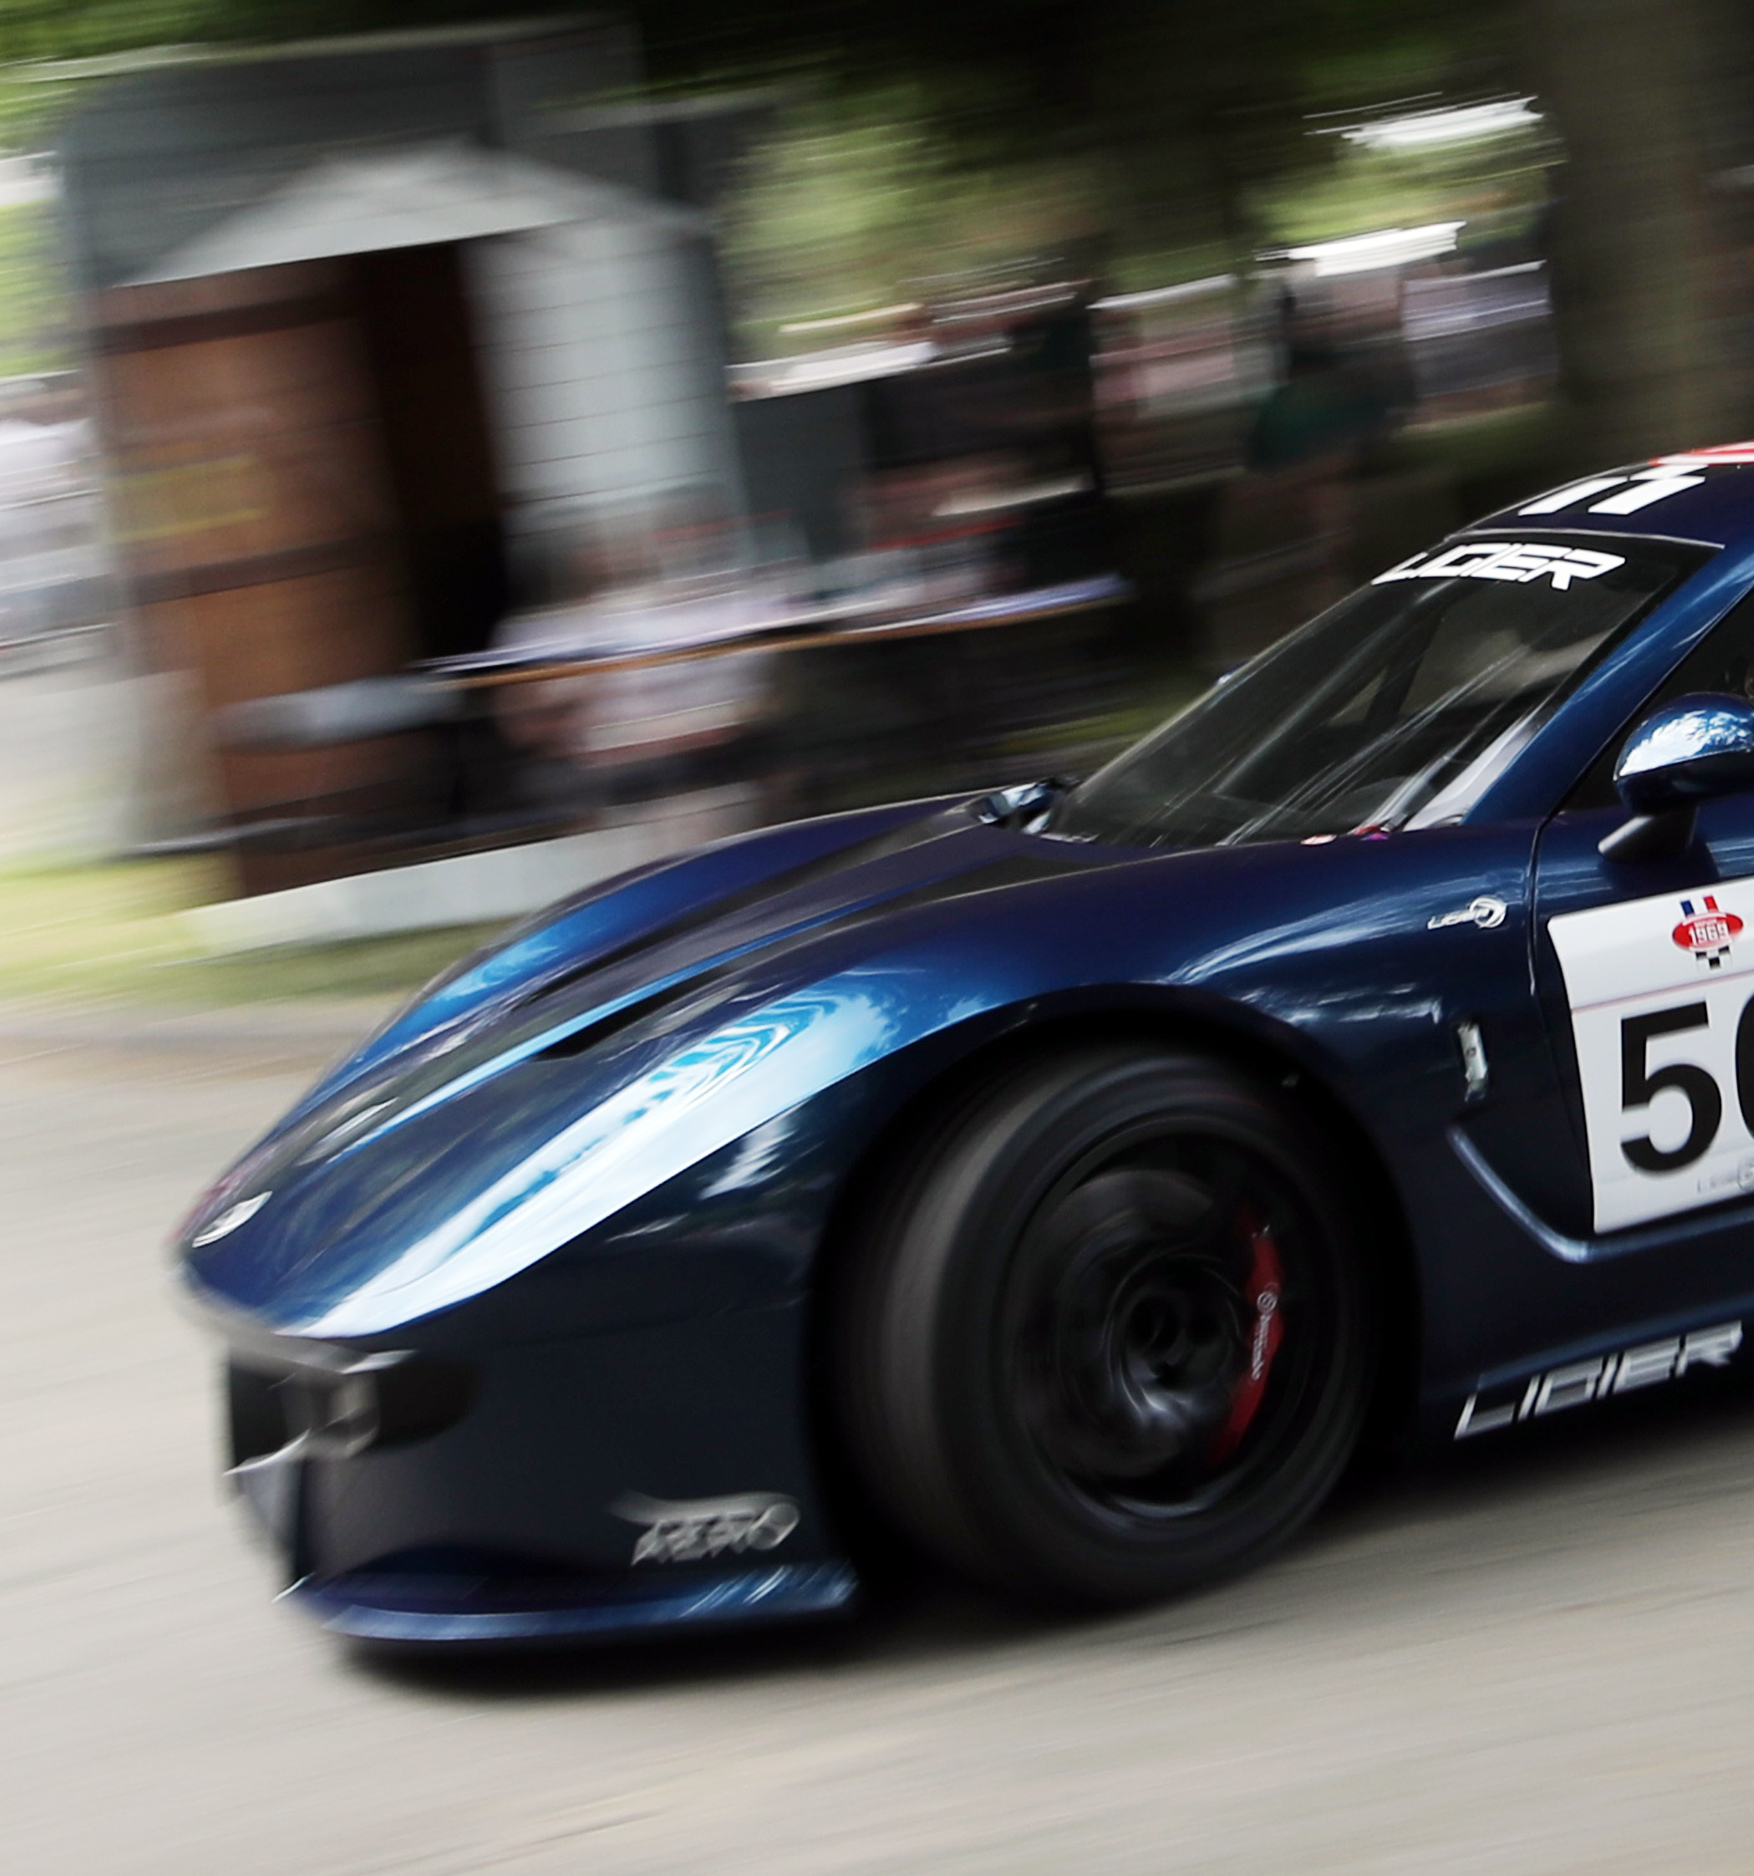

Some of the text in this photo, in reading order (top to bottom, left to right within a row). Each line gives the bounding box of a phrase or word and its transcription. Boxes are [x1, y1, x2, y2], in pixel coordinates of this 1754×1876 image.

[1371, 542, 1627, 591] LIGIER
[1687, 918, 1732, 947] 1969
[1454, 1320, 1743, 1440] LIGIER
